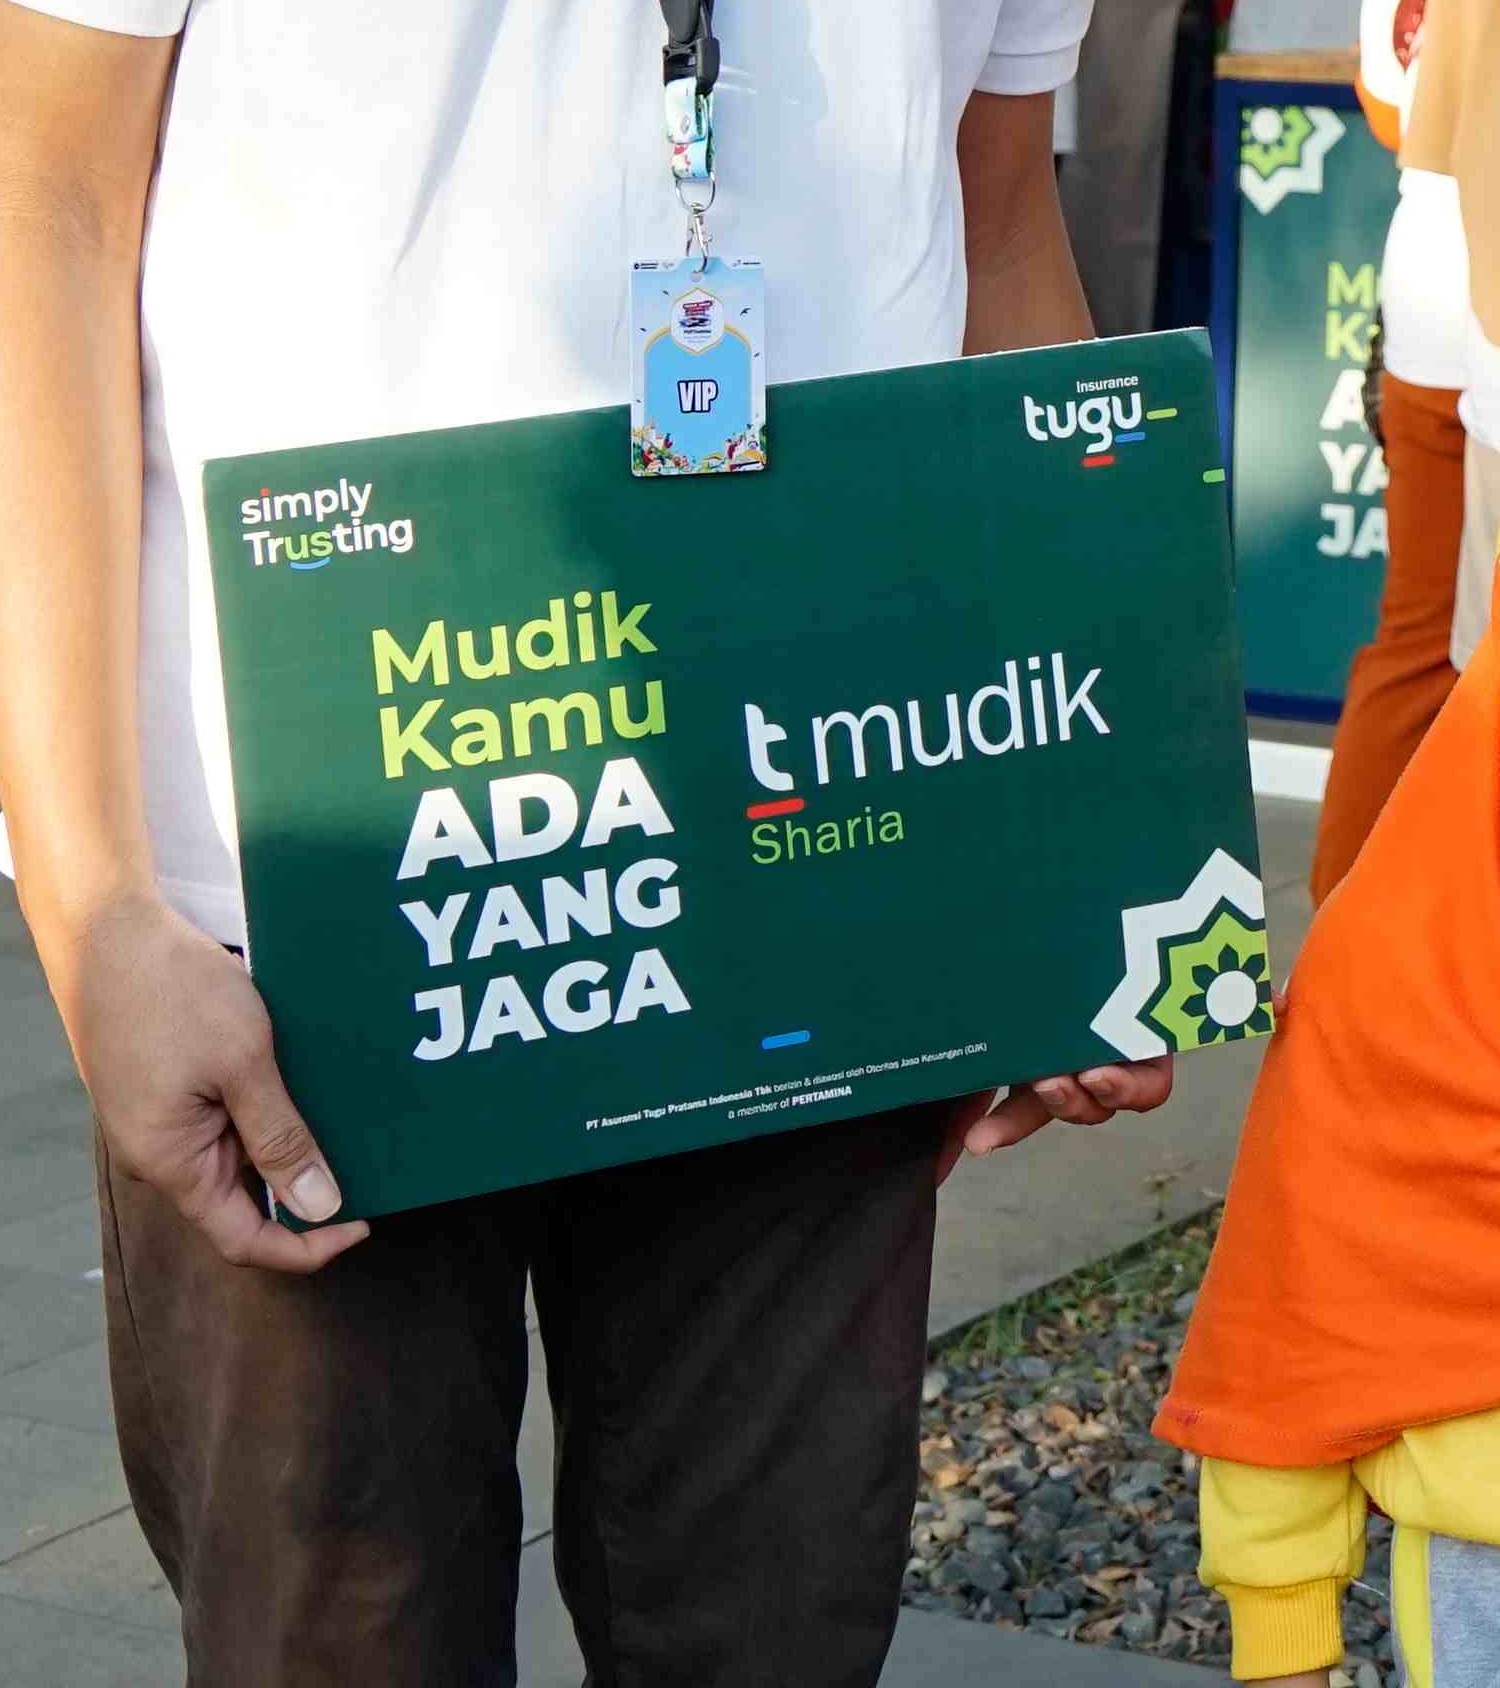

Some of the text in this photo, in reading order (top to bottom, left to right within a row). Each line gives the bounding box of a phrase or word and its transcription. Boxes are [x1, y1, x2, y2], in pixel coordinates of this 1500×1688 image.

[1327, 262, 1382, 306] M
[1325, 310, 1381, 361] K
[678, 380, 718, 413] VIP
[1076, 376, 1139, 394] Insurance
[1023, 392, 1143, 453] tugu
[241, 478, 373, 525] simply
[243, 518, 414, 567] Trusting
[371, 590, 658, 695] Mudik
[379, 679, 667, 779] Kamu
[396, 757, 675, 880] ADA
[751, 807, 905, 864] Sharia
[400, 857, 682, 967] YANG
[412, 948, 692, 1062] JAGA
[586, 1119, 599, 1130] PT
[601, 1111, 641, 1128] Asuransi
[642, 1105, 666, 1120] Tugu
[667, 1098, 708, 1115] Pratama
[709, 1088, 753, 1107] Indonesia
[754, 1084, 772, 1097] Tbk
[804, 1078, 812, 1088] &
[965, 1042, 988, 1057] (OJK)
[727, 1085, 852, 1119] a member of PERTAMINA
